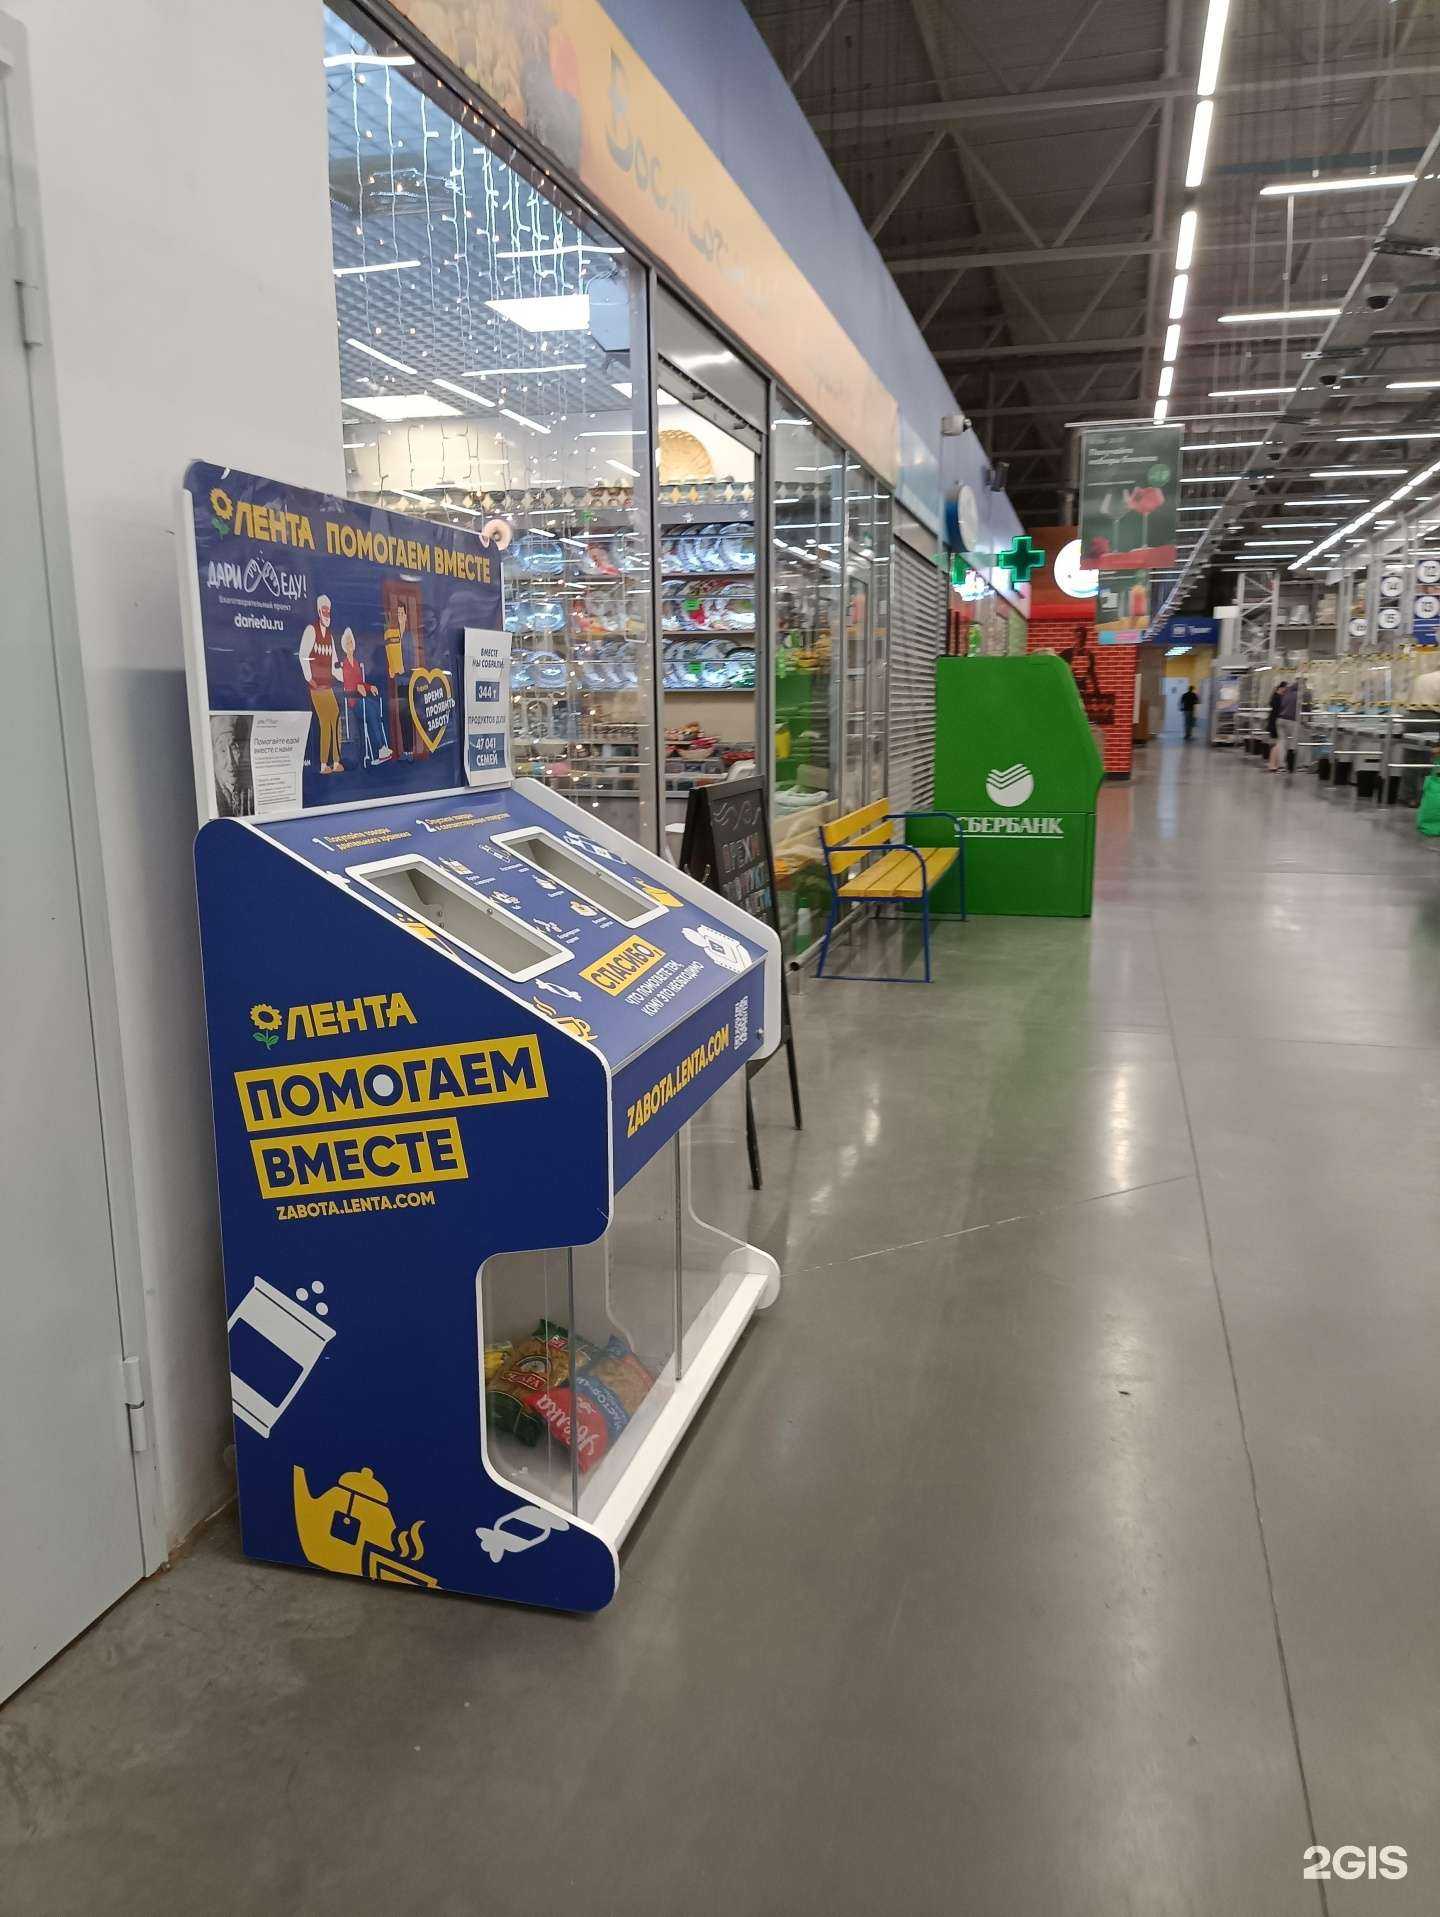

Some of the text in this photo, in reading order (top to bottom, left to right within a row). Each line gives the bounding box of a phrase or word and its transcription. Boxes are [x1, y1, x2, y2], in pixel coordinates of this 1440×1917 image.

[234, 501, 491, 584] ЛЕНТА ПОМОГАЕМ ВМЕСТЕ
[207, 560, 307, 600] ДАРИ ЕДУ!
[234, 613, 284, 631] dariedu.ru
[424, 688, 443, 704] ВРЕМЯ
[428, 710, 450, 731] ЗАБОТУ
[477, 750, 497, 766] СЕМЕЙ
[954, 817, 1064, 833] СБЕРБАНК
[286, 993, 417, 1041] ЛЕНТА
[246, 1047, 537, 1121] ПОМОГАЕМ
[627, 1023, 729, 1138] ZABOTA.LENTA.COM
[261, 1129, 458, 1188] ВМЕСТЕ
[276, 1190, 435, 1221] ZABOTA.LENTA.COM
